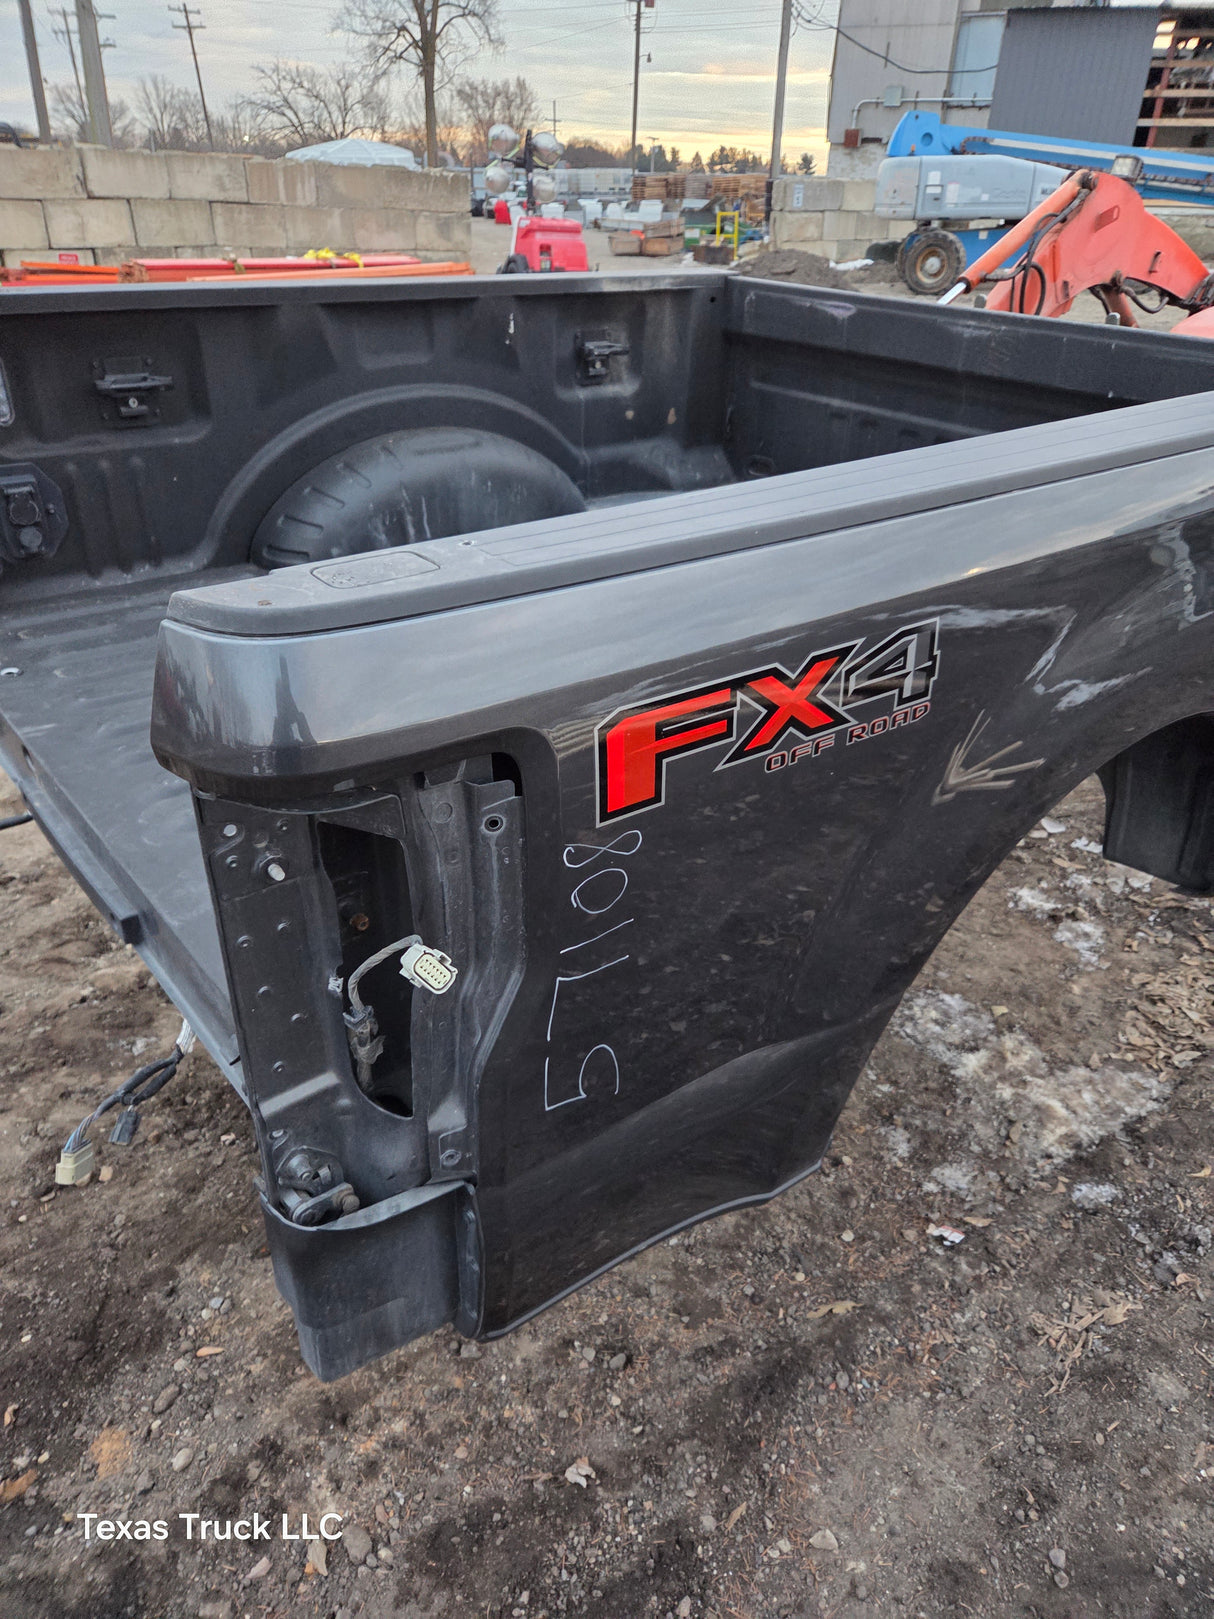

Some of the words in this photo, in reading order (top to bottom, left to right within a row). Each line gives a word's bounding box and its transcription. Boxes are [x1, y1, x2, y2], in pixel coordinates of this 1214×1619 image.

[595, 617, 941, 828] FX4
[765, 738, 835, 773] OFF
[846, 703, 931, 746] ROAD
[544, 829, 643, 1111] 57108
